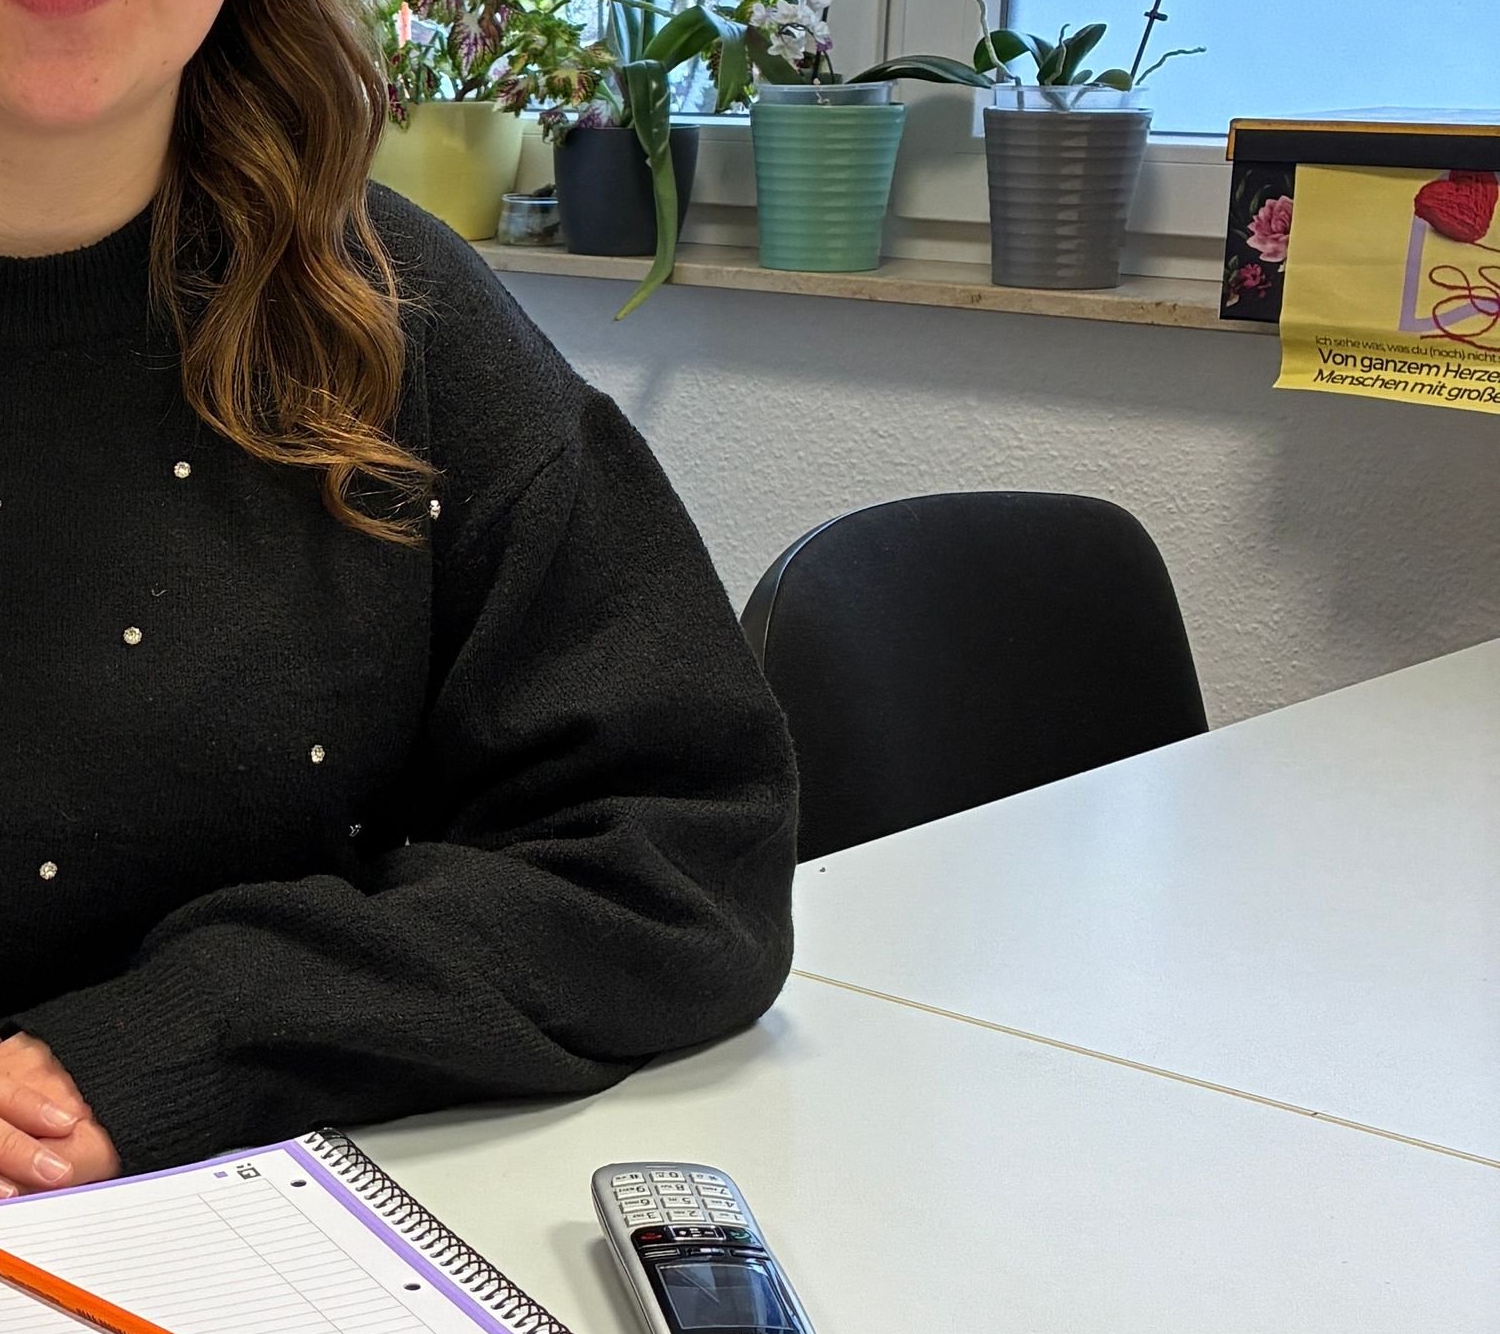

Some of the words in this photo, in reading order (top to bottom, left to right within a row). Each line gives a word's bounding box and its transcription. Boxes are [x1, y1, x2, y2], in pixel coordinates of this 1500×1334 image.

[1315, 335, 1332, 346] Ich
[1333, 338, 1361, 349] sehe
[1387, 344, 1410, 354] was
[1411, 345, 1428, 356] du
[1430, 347, 1466, 361] (noch)
[1467, 351, 1497, 363] nicht
[1318, 347, 1357, 368] Von
[1360, 356, 1441, 378] ganzem
[1442, 362, 1500, 384] Herze
[1313, 368, 1409, 393] Menschen
[1410, 380, 1447, 397] mit
